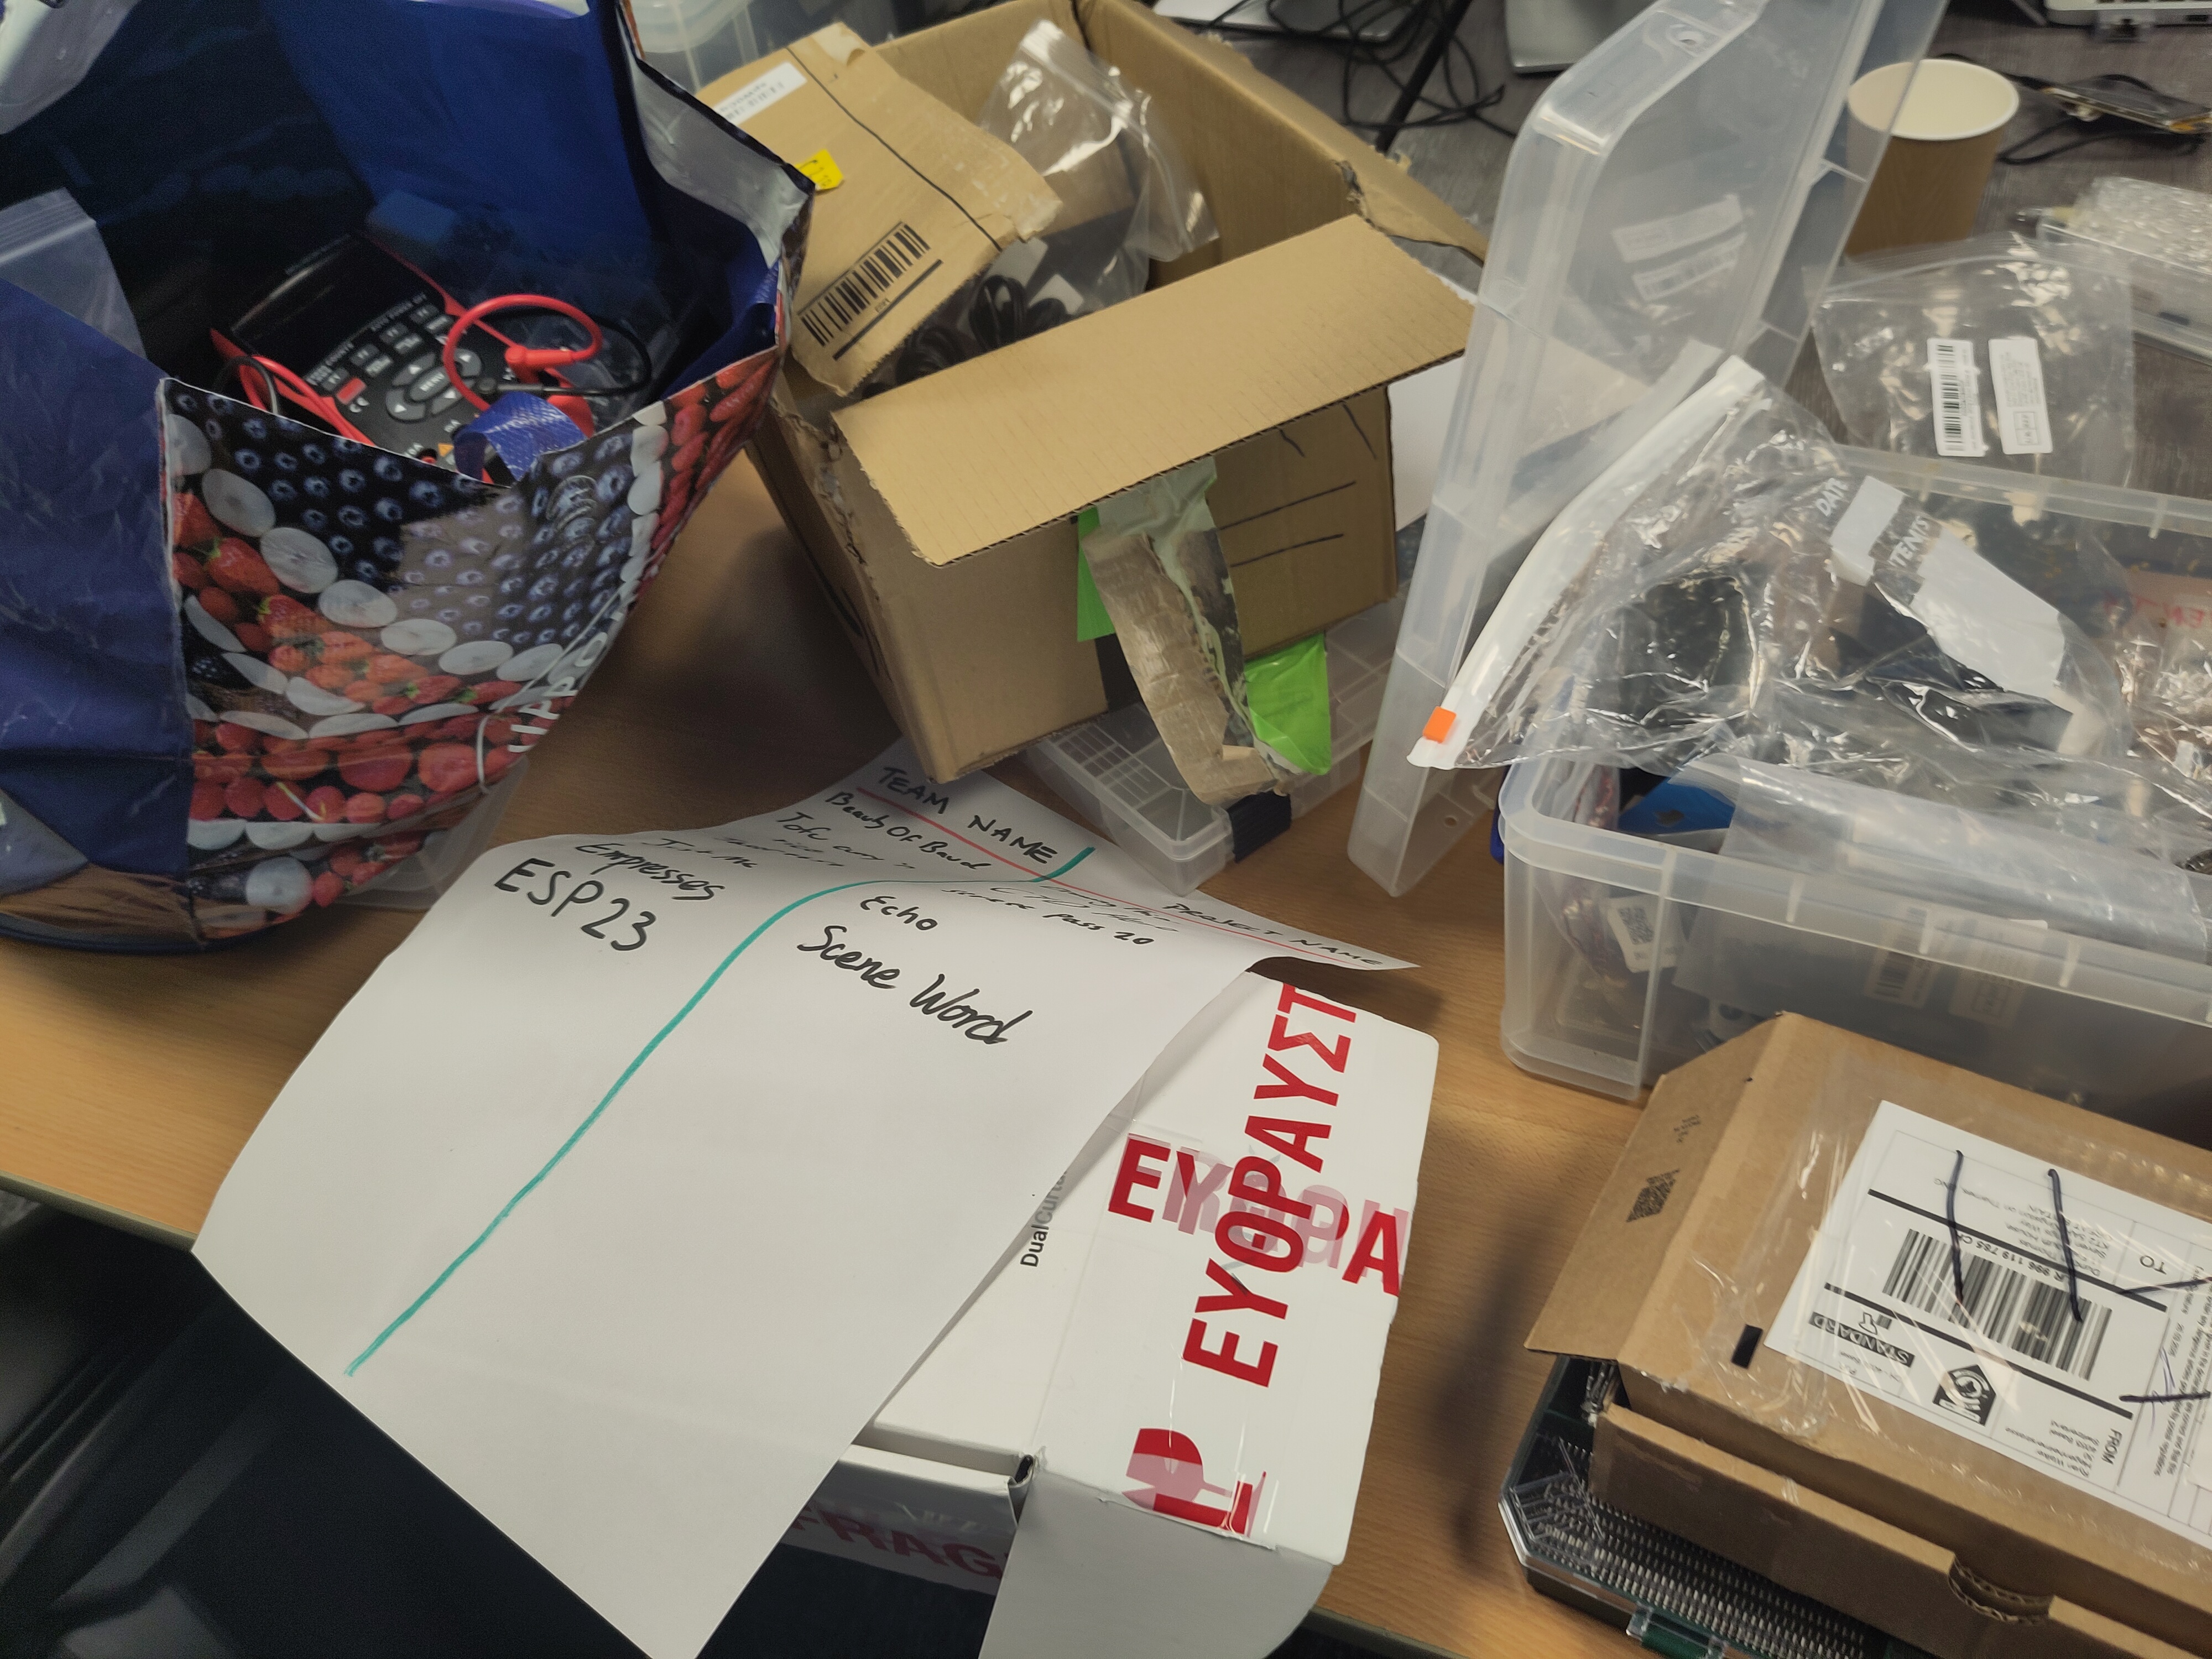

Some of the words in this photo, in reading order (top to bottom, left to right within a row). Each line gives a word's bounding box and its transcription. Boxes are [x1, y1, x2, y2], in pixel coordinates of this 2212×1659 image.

[420, 372, 445, 392] MENU
[877, 767, 951, 815] TEAM
[967, 815, 1060, 864] NAME
[575, 843, 727, 901] Empresses
[493, 858, 658, 951] ESP23
[859, 895, 939, 931] Echo
[1162, 902, 1285, 937] PROJECT
[1290, 937, 1385, 967] NAME
[796, 925, 901, 990] Scene
[909, 974, 1034, 1045] Word
[2000, 1249, 2025, 1266] 119
[2137, 1253, 2169, 1275] TO
[1810, 1313, 1912, 1364] STANDARD
[2098, 1427, 2125, 1465] FROM
